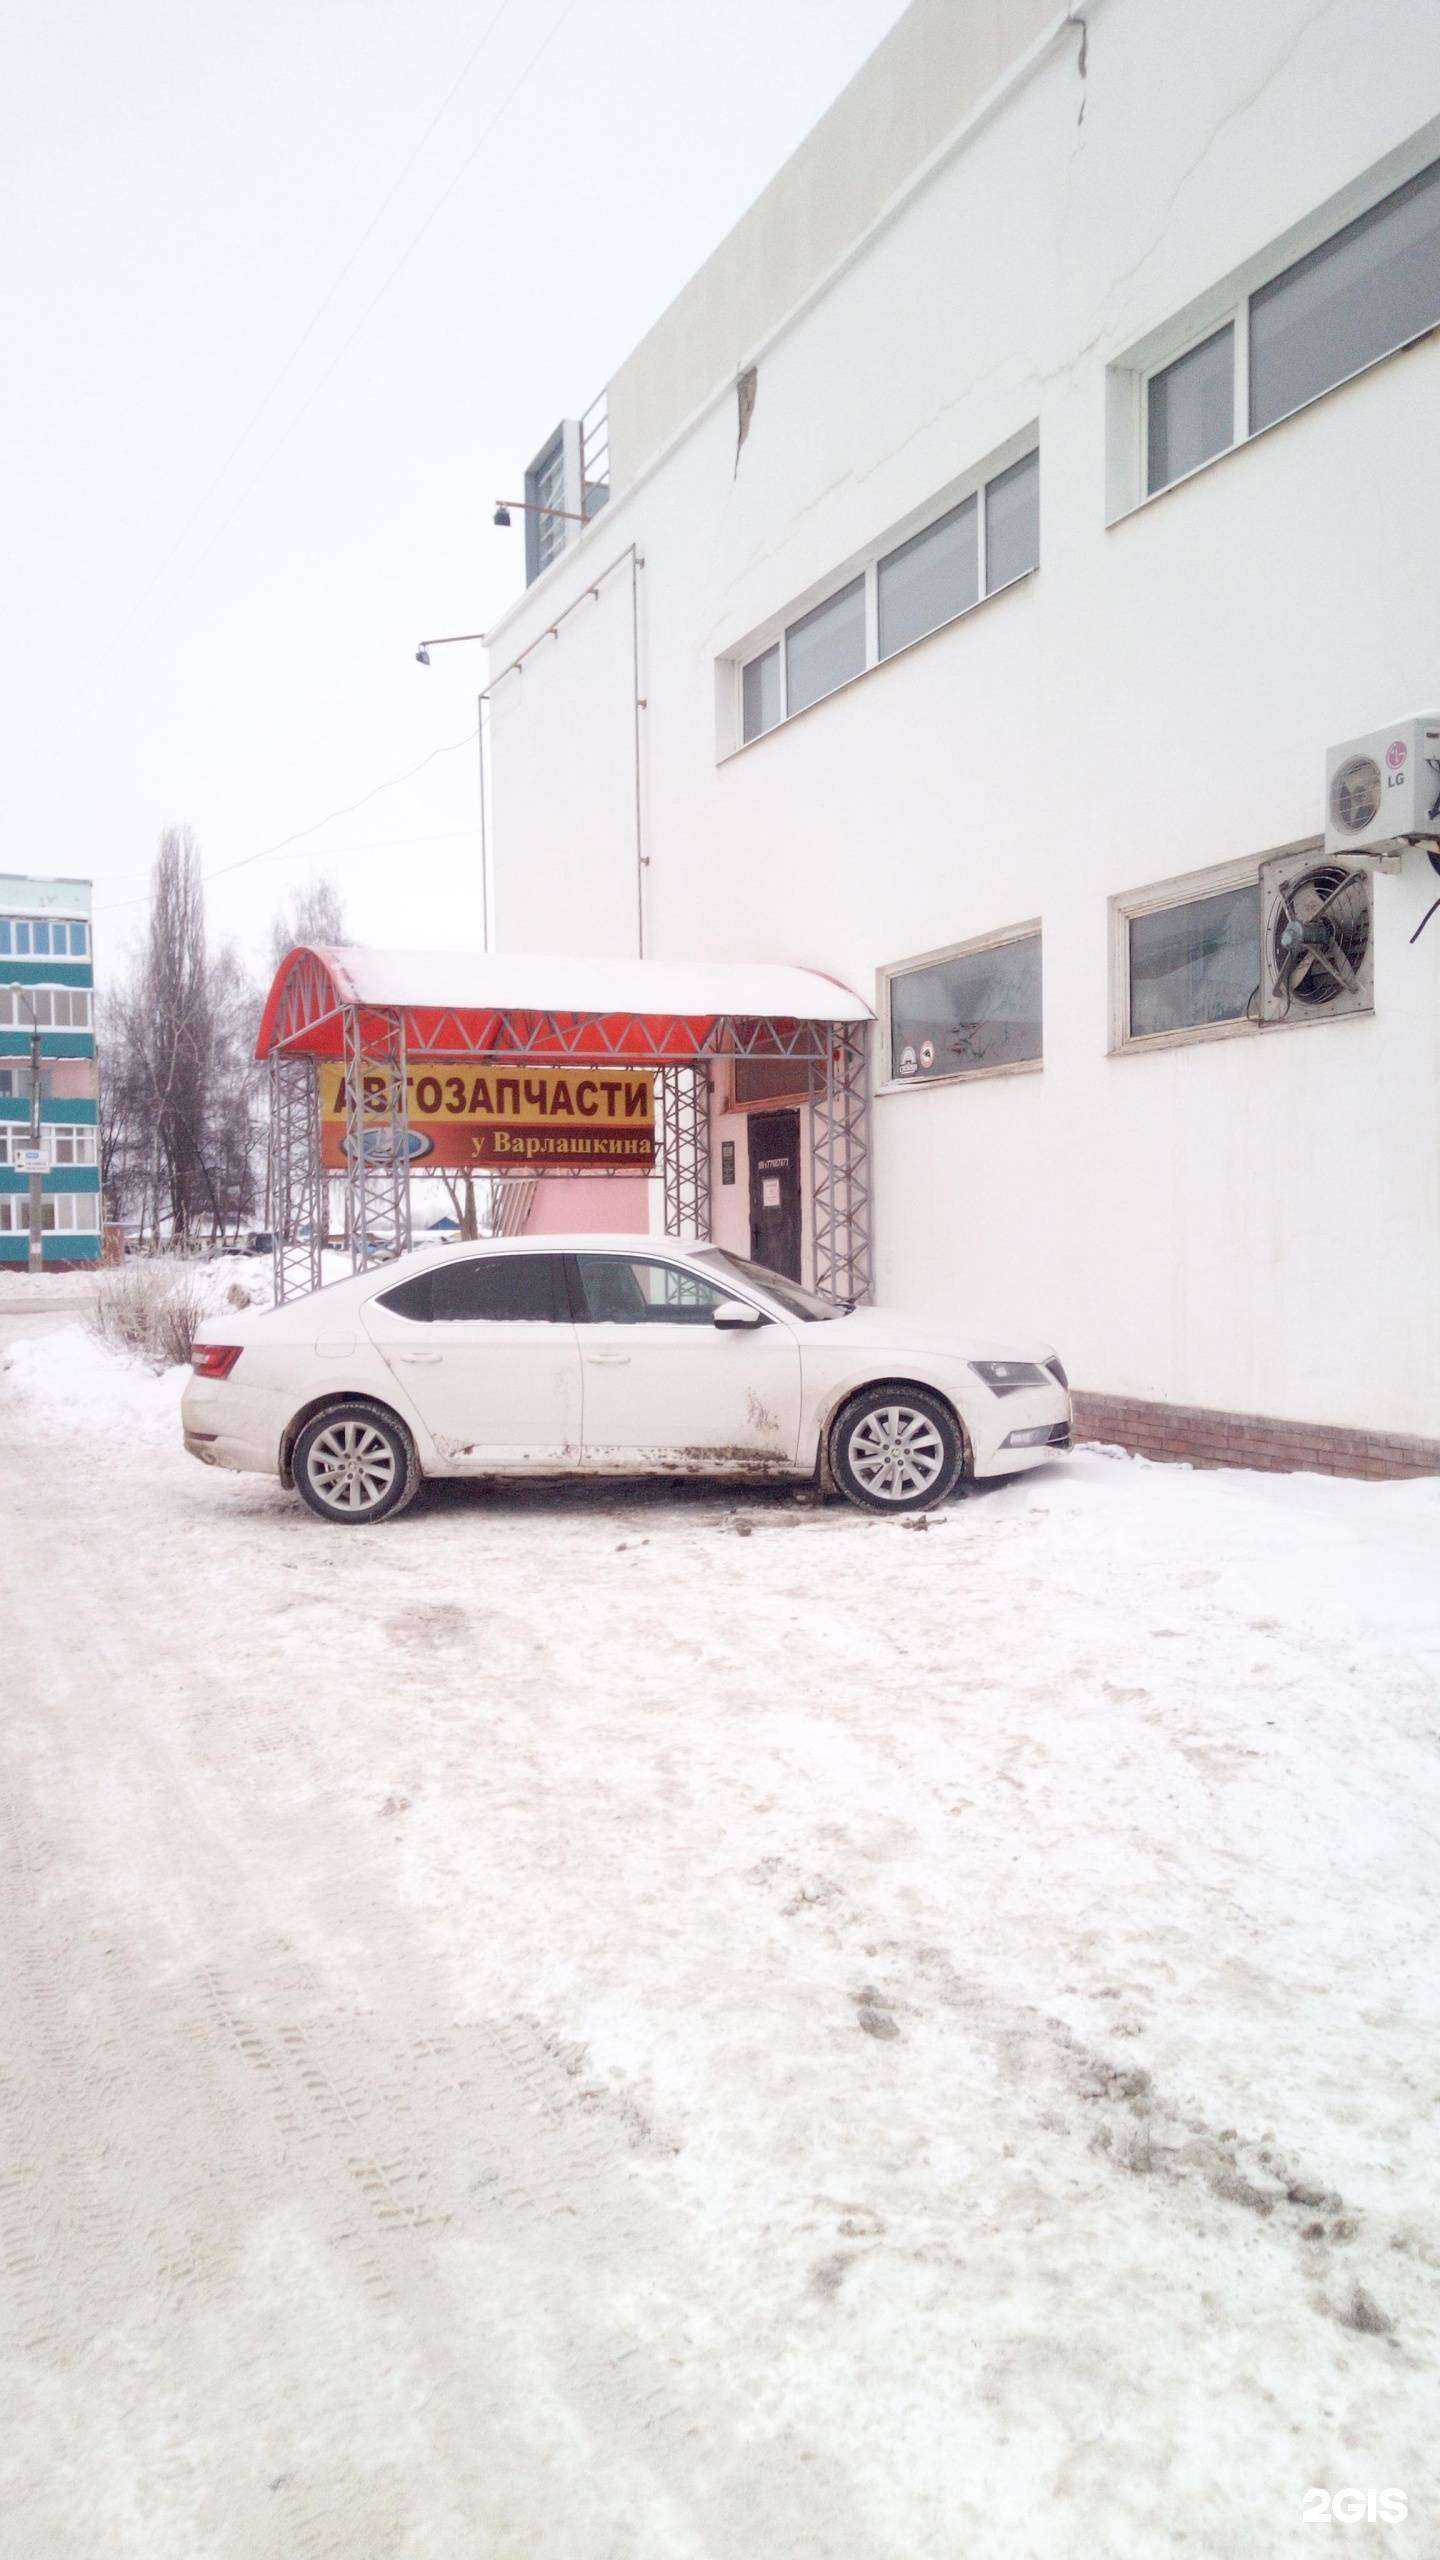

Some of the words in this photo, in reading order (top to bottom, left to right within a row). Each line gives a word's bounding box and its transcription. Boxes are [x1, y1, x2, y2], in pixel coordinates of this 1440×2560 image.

[1388, 772, 1404, 788] LG
[472, 1136, 485, 1157] у
[493, 1131, 651, 1158] Варлашкина
